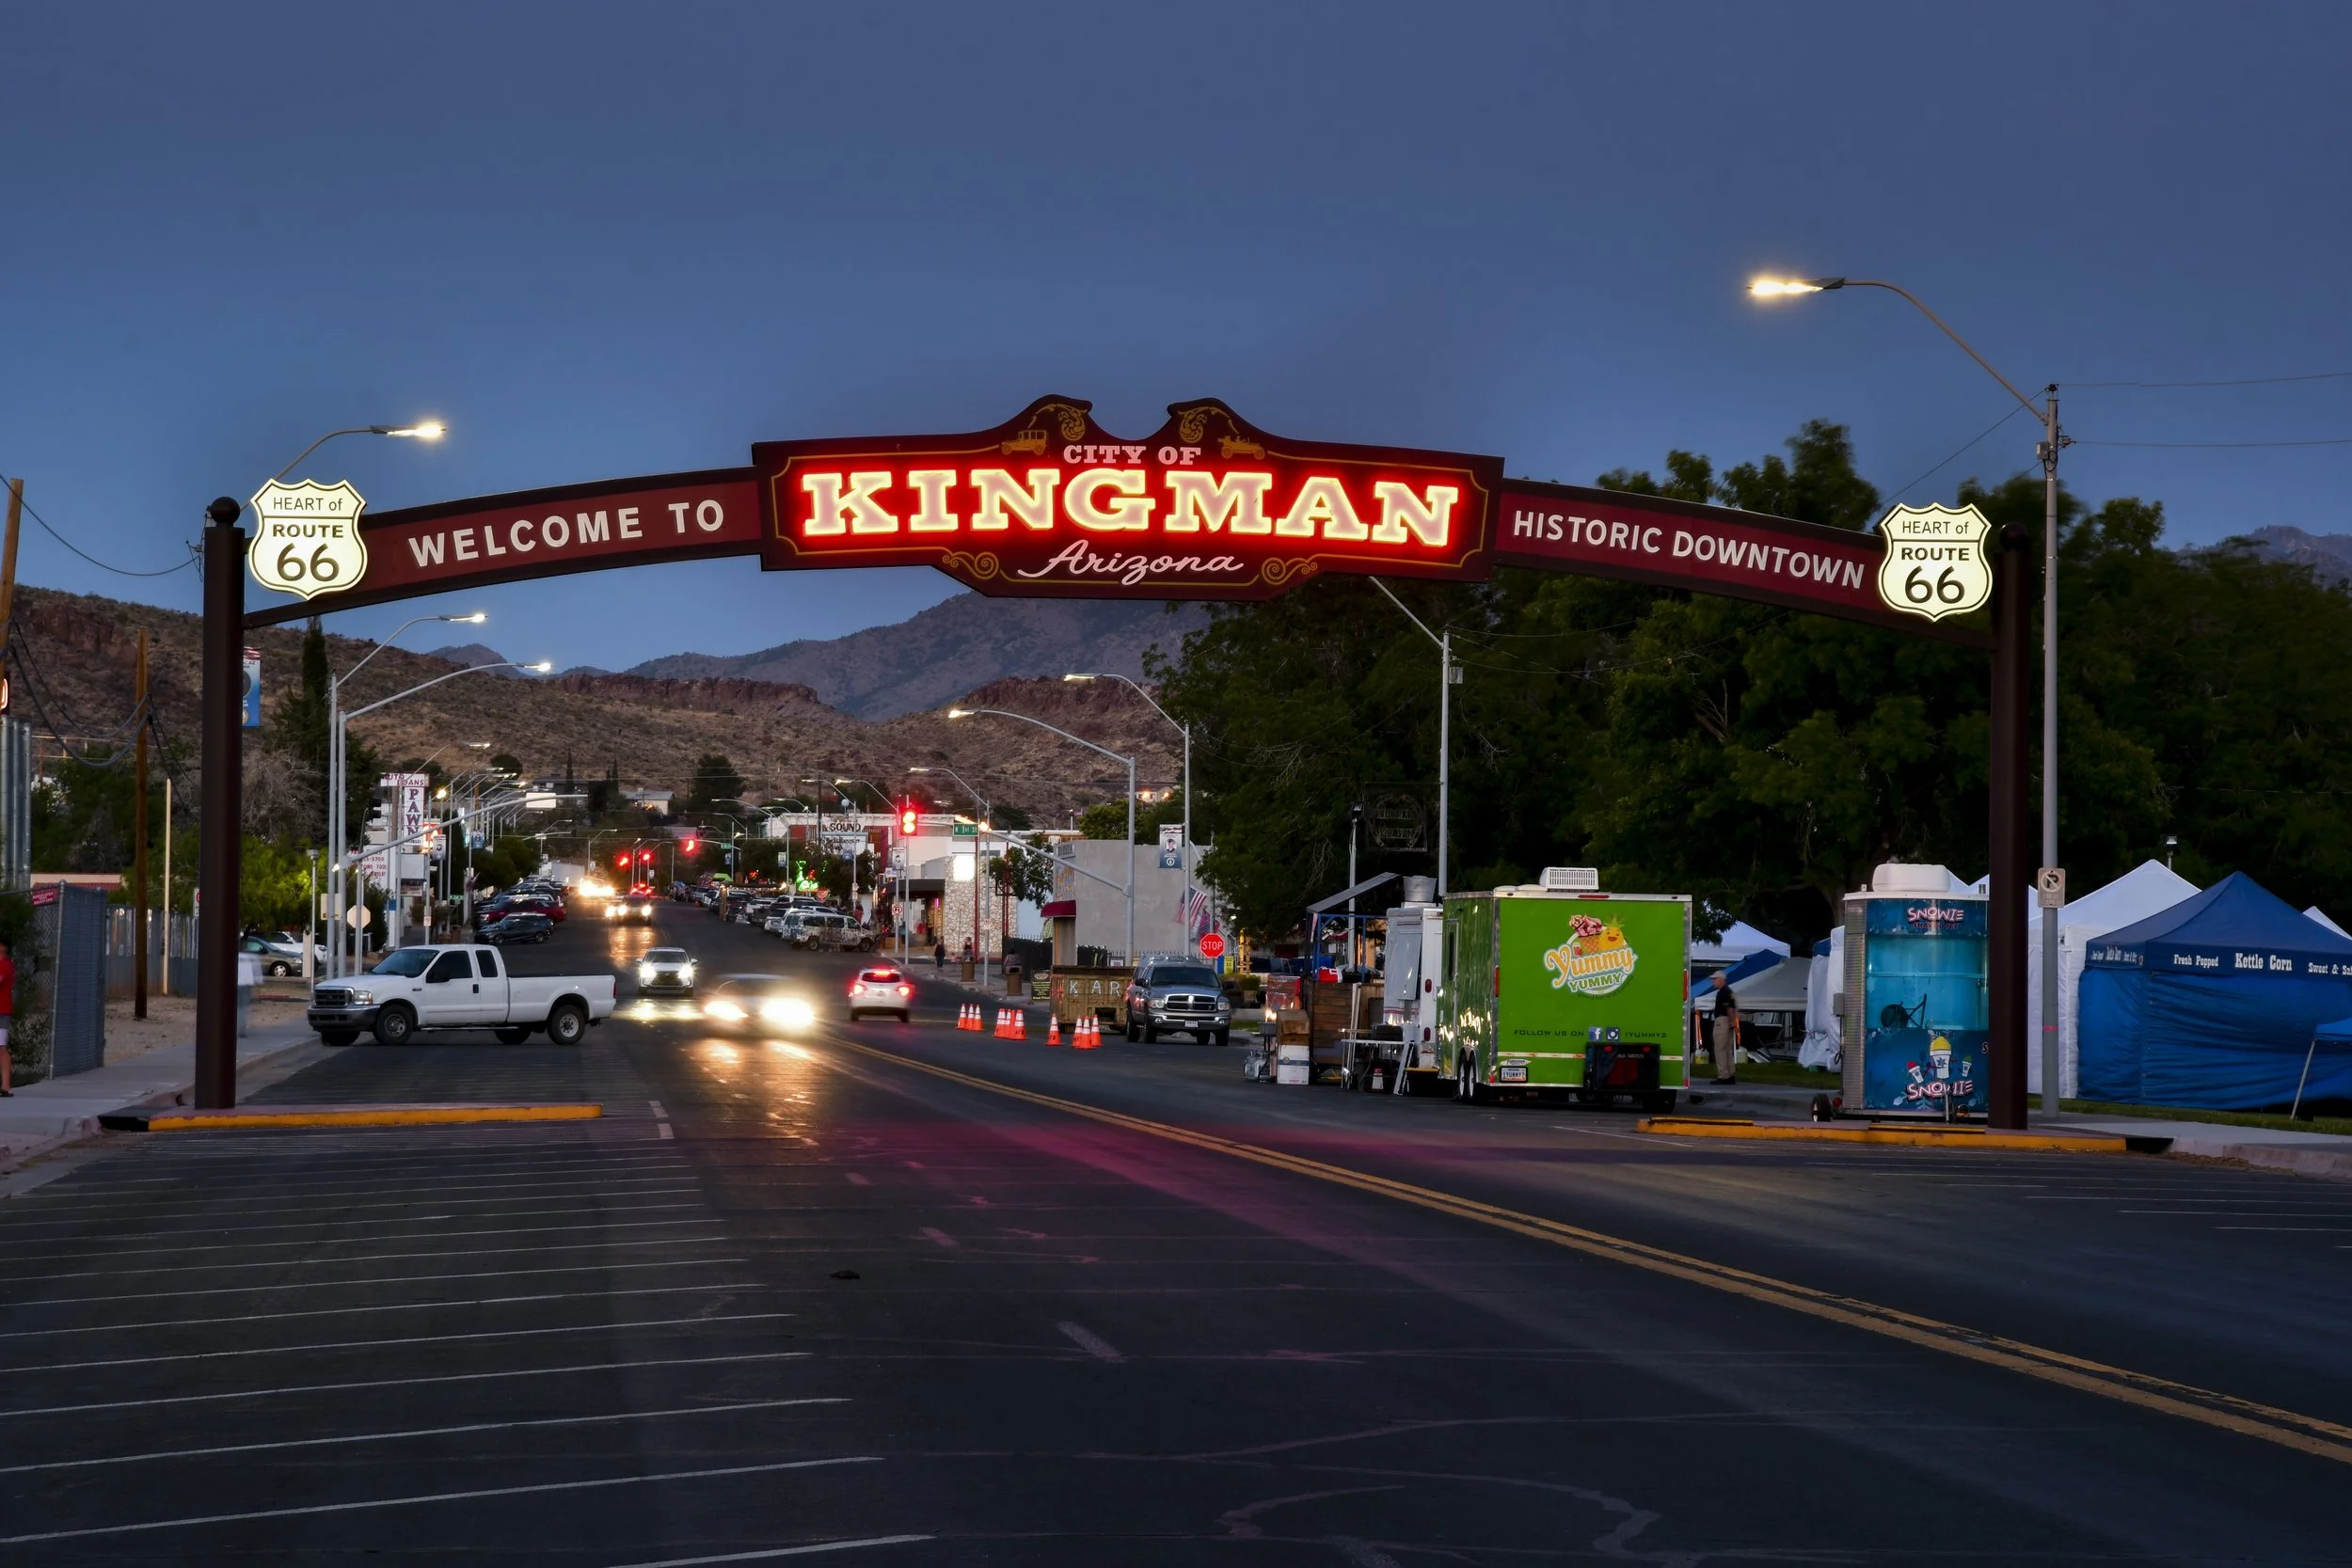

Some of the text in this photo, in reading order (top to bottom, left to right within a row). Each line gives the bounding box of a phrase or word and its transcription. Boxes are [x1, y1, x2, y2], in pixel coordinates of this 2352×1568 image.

[1062, 444, 1202, 467] CITY OF
[273, 495, 343, 512] HEART of
[802, 467, 1459, 547] KINGMAN
[272, 522, 344, 539] ROUTE
[407, 499, 724, 568] WELCOME TO
[1902, 519, 1970, 535] HEART of
[1513, 509, 1866, 590] HISTORIC DOWNTOWN
[1901, 546, 1970, 562] ROUTE
[276, 541, 340, 582] 66
[1016, 539, 1244, 586] Arizona
[1904, 564, 1966, 605] 66
[405, 788, 421, 836] PAWN
[829, 822, 861, 832] SOUND
[1906, 906, 1965, 924] SNOWIE
[1201, 941, 1223, 951] STOP
[1544, 943, 1638, 990] Yummy
[2173, 953, 2219, 969] Fresh Popped
[2234, 952, 2293, 972] Kettle Corn
[2308, 961, 2328, 974] Sweet
[2331, 964, 2339, 975] &
[1567, 973, 1623, 992] YUMMY
